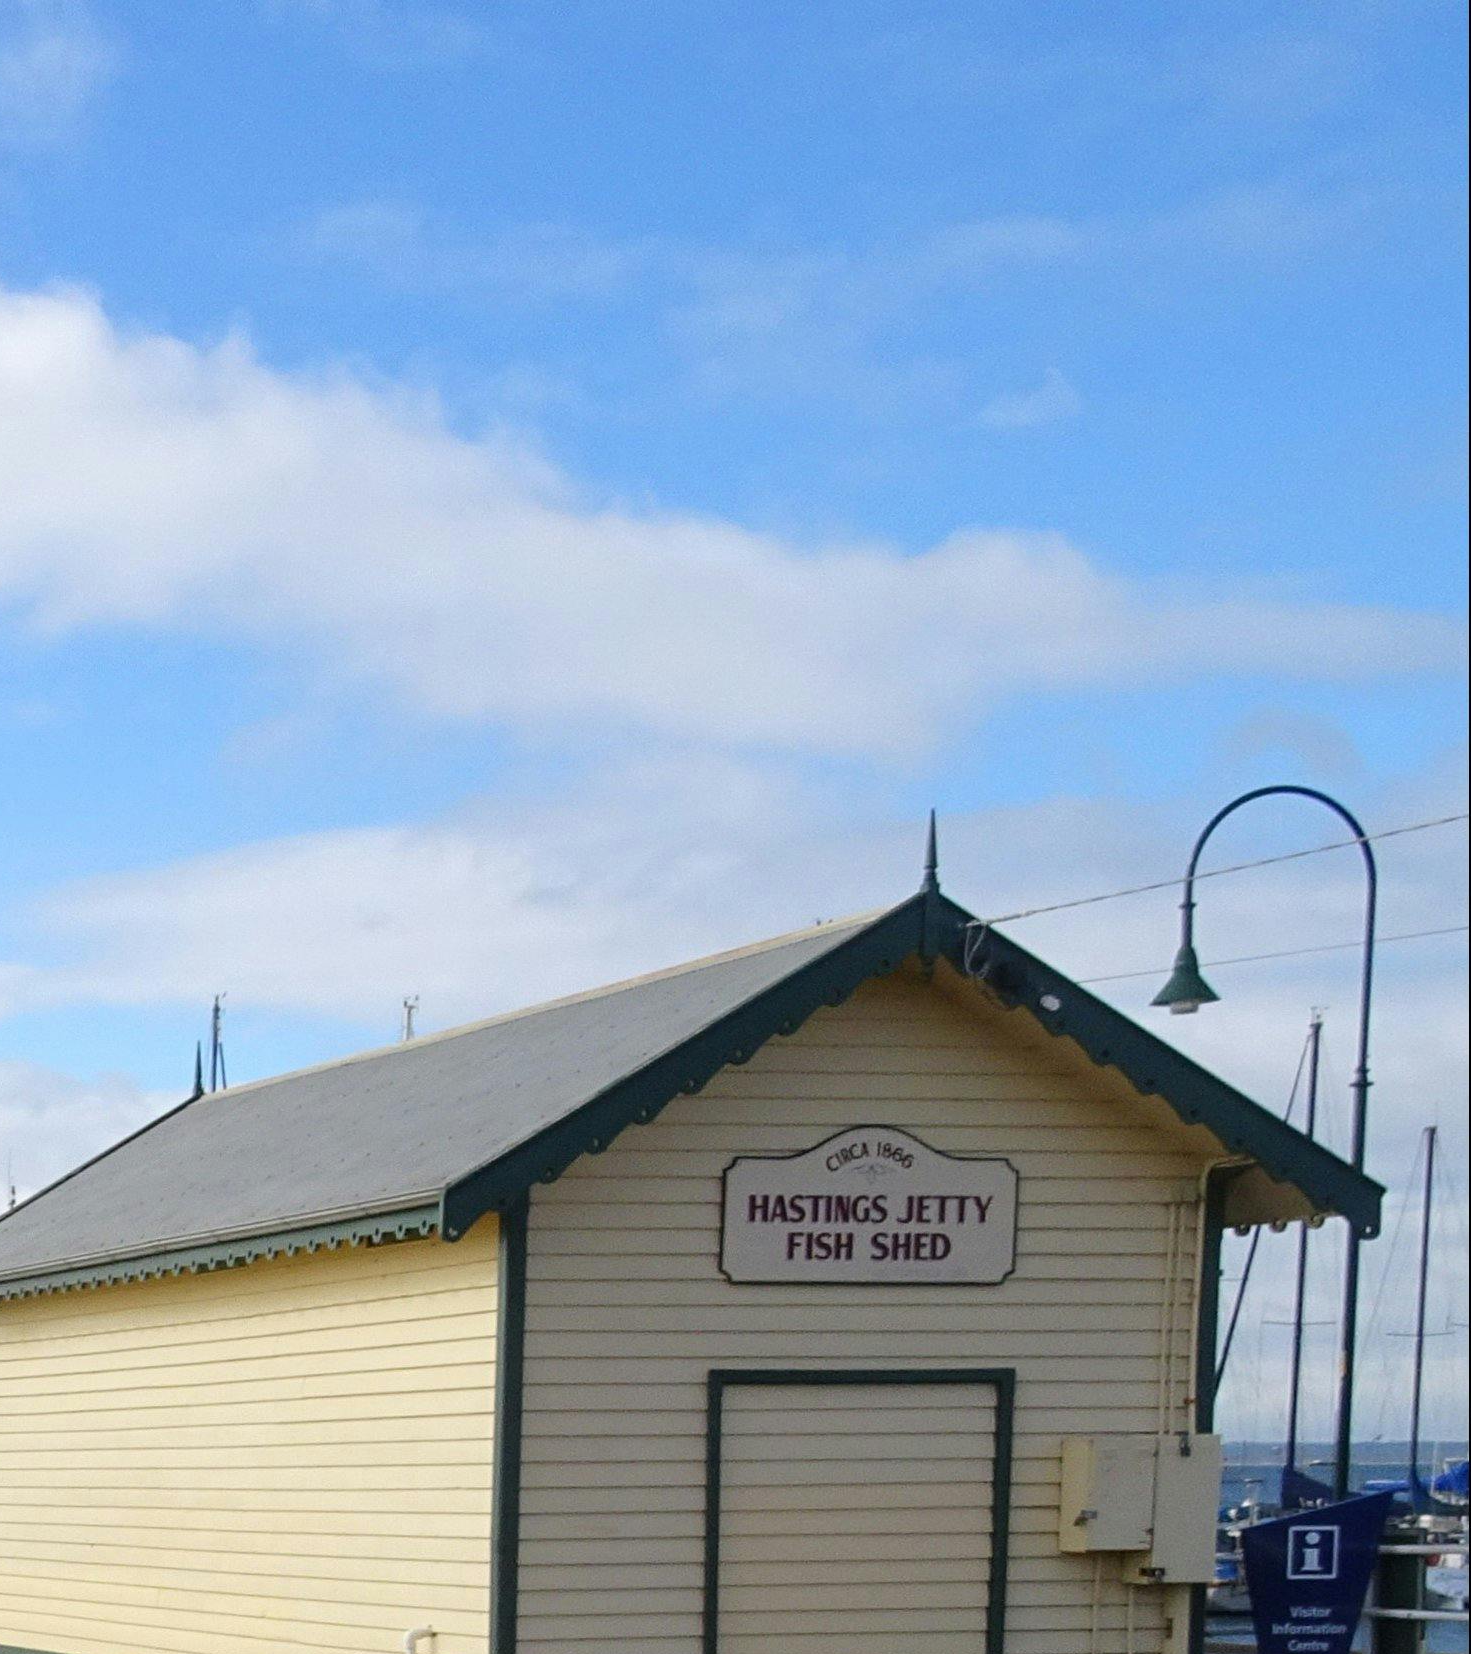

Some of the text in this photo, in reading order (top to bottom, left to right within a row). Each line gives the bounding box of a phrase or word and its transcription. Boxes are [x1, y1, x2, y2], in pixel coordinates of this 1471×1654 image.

[826, 1142, 869, 1172] CIRCA
[747, 1194, 993, 1224] HASTINGS JETTY
[786, 1232, 951, 1260] FISH SHED
[1289, 1606, 1332, 1618] Visitor
[1271, 1622, 1347, 1635] Information
[1287, 1640, 1329, 1651] Centre
